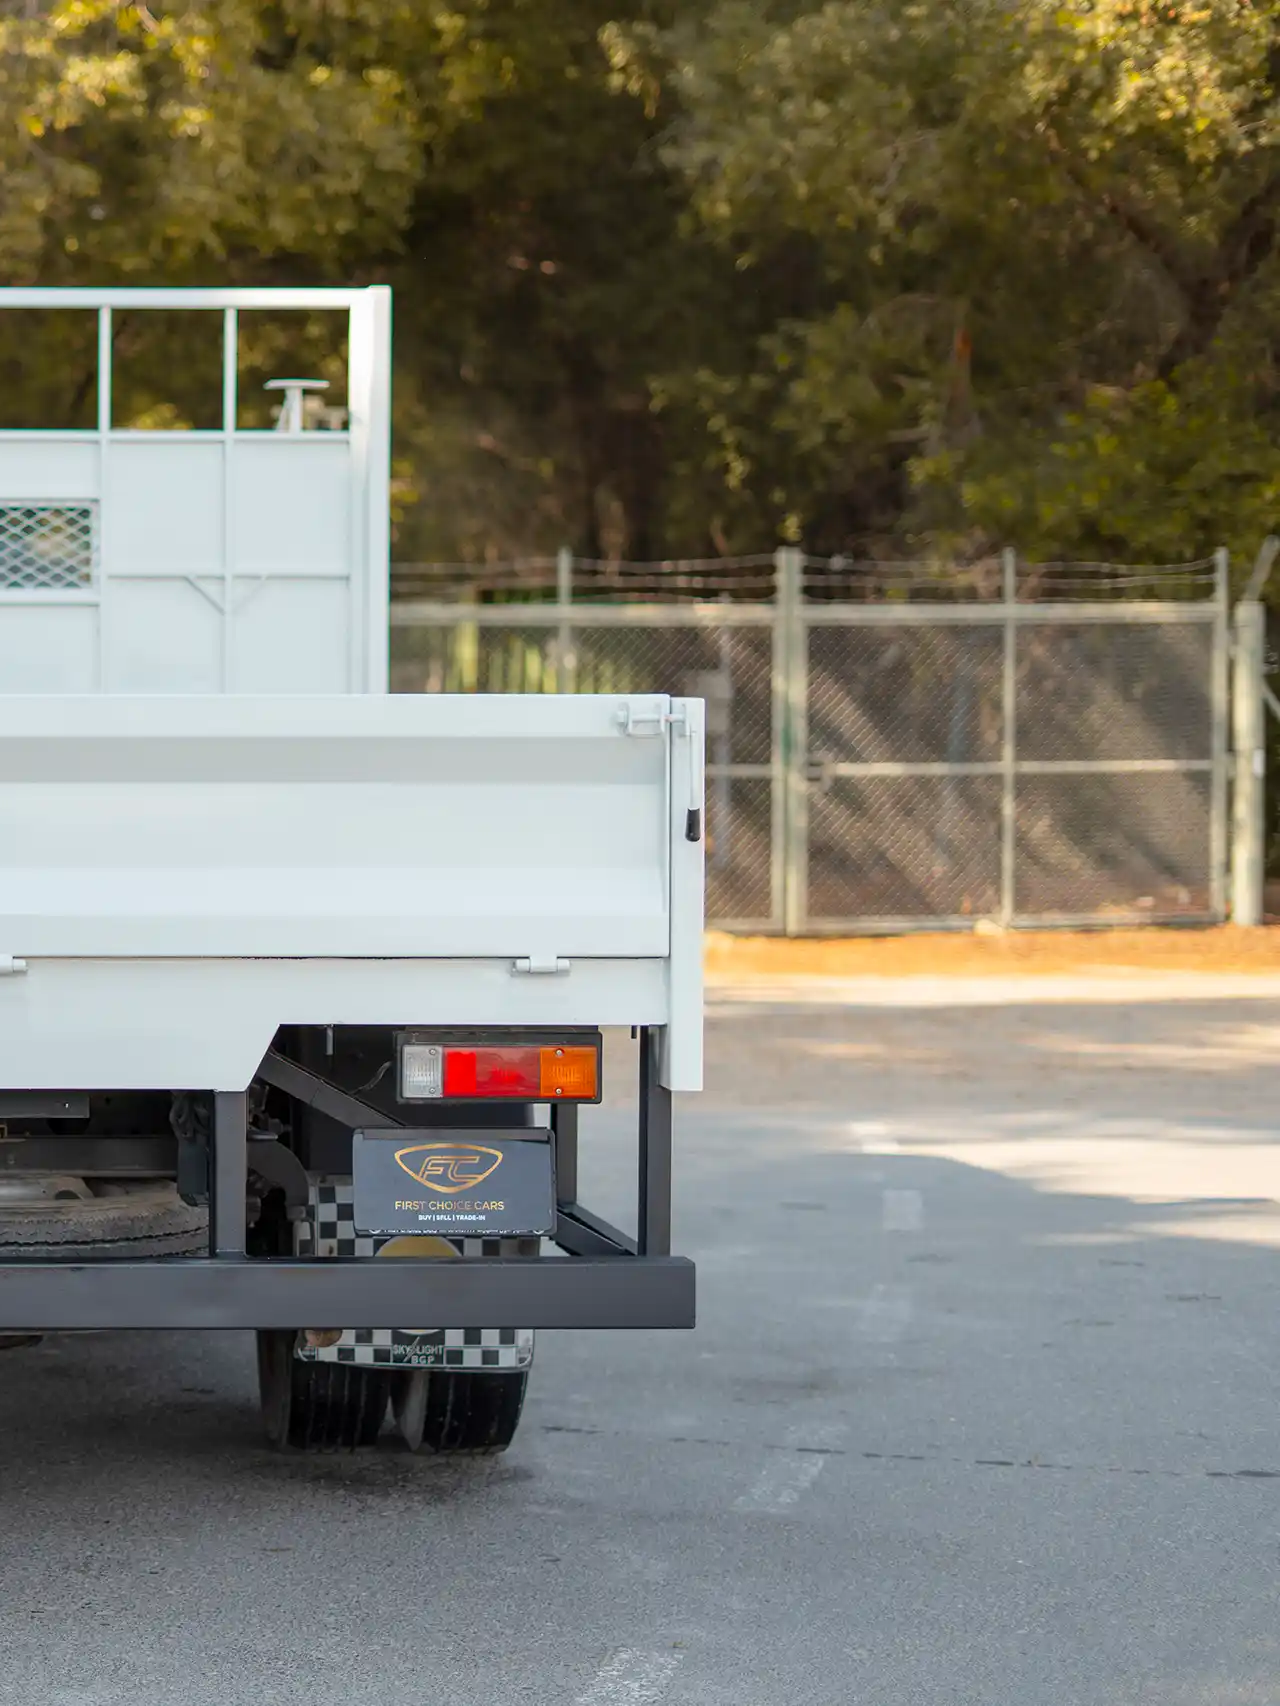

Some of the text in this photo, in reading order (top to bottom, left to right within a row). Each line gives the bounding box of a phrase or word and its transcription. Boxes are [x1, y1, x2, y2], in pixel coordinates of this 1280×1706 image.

[394, 1200, 505, 1211] FIRST CHOICE CARS
